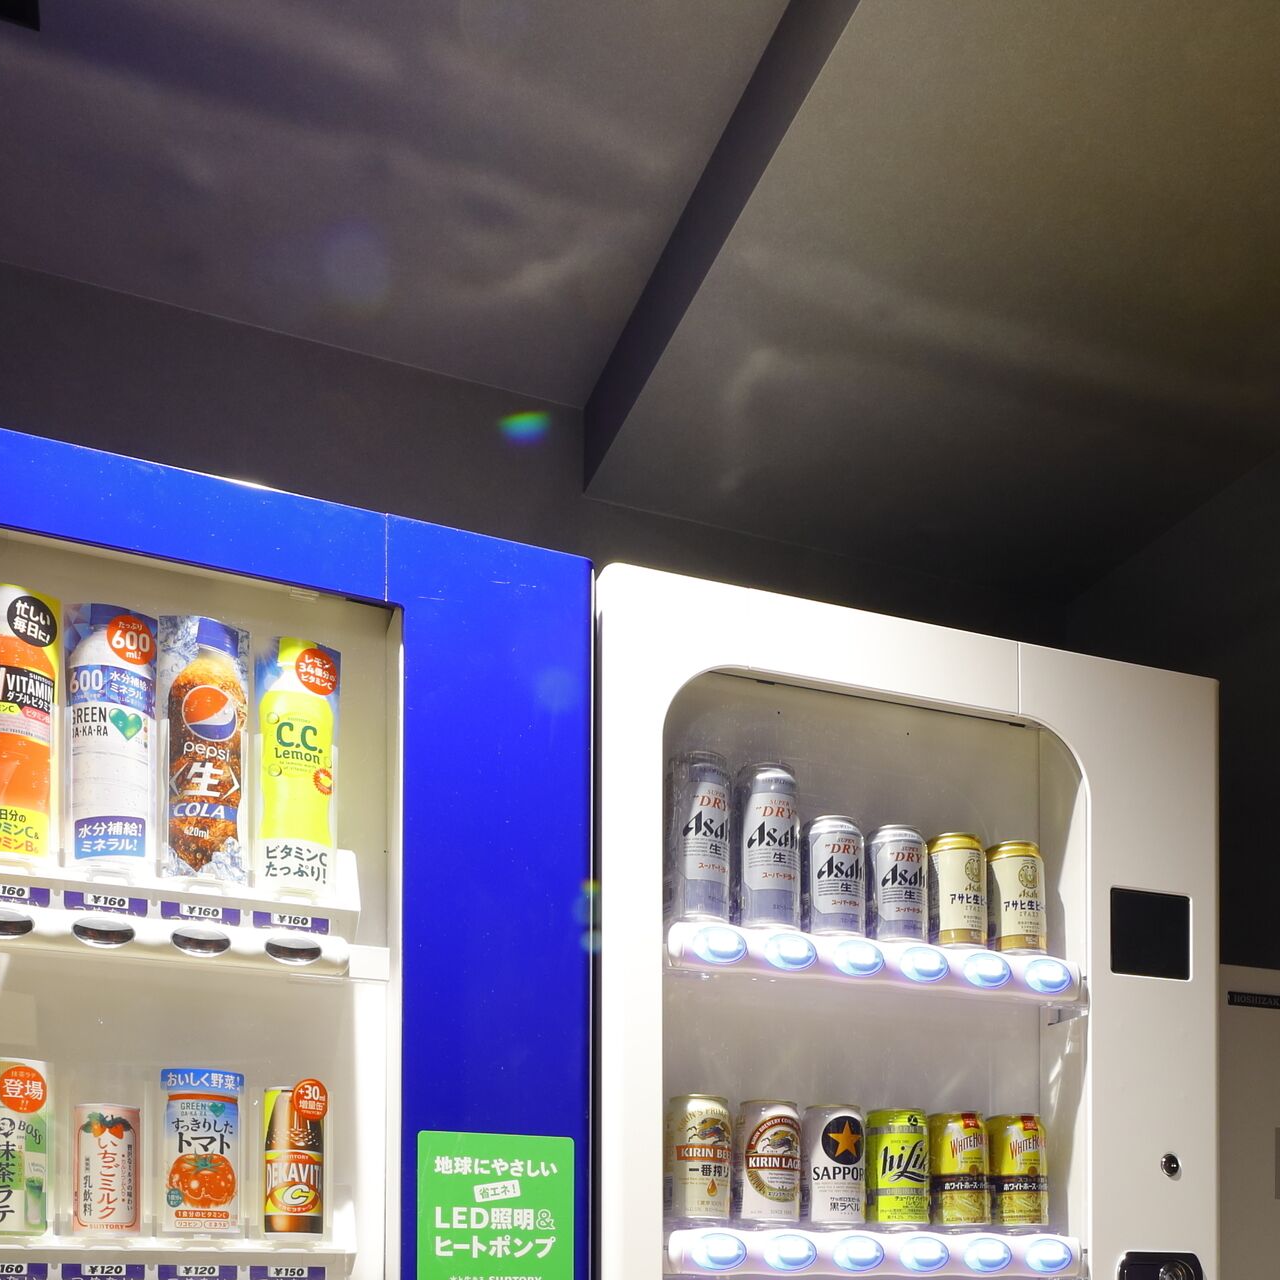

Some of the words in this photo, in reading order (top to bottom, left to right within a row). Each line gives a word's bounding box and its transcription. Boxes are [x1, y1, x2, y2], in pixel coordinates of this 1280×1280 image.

[15, 600, 50, 626] 忙しい
[111, 630, 150, 652] 600
[183, 740, 230, 762] pepsi
[275, 747, 321, 765] Lemon
[173, 803, 226, 818] COLA
[710, 843, 722, 856] 生
[773, 853, 786, 863] 生
[186, 906, 220, 917] ¥160
[2, 1079, 43, 1100] 登場
[171, 1118, 234, 1134] すっきりした
[178, 1132, 231, 1154] トマト
[682, 1147, 713, 1157] KIRIN
[434, 1156, 558, 1176] 地球にやさしい
[749, 1157, 780, 1167] KIRIN
[689, 1164, 729, 1176] 一番搾り
[98, 1137, 118, 1220] いちごミルク
[830, 1203, 860, 1211] 黒ラベル
[435, 1235, 556, 1258] ヒートポンプ
[89, 1265, 122, 1274] ¥120
[183, 1266, 215, 1275] ¥120
